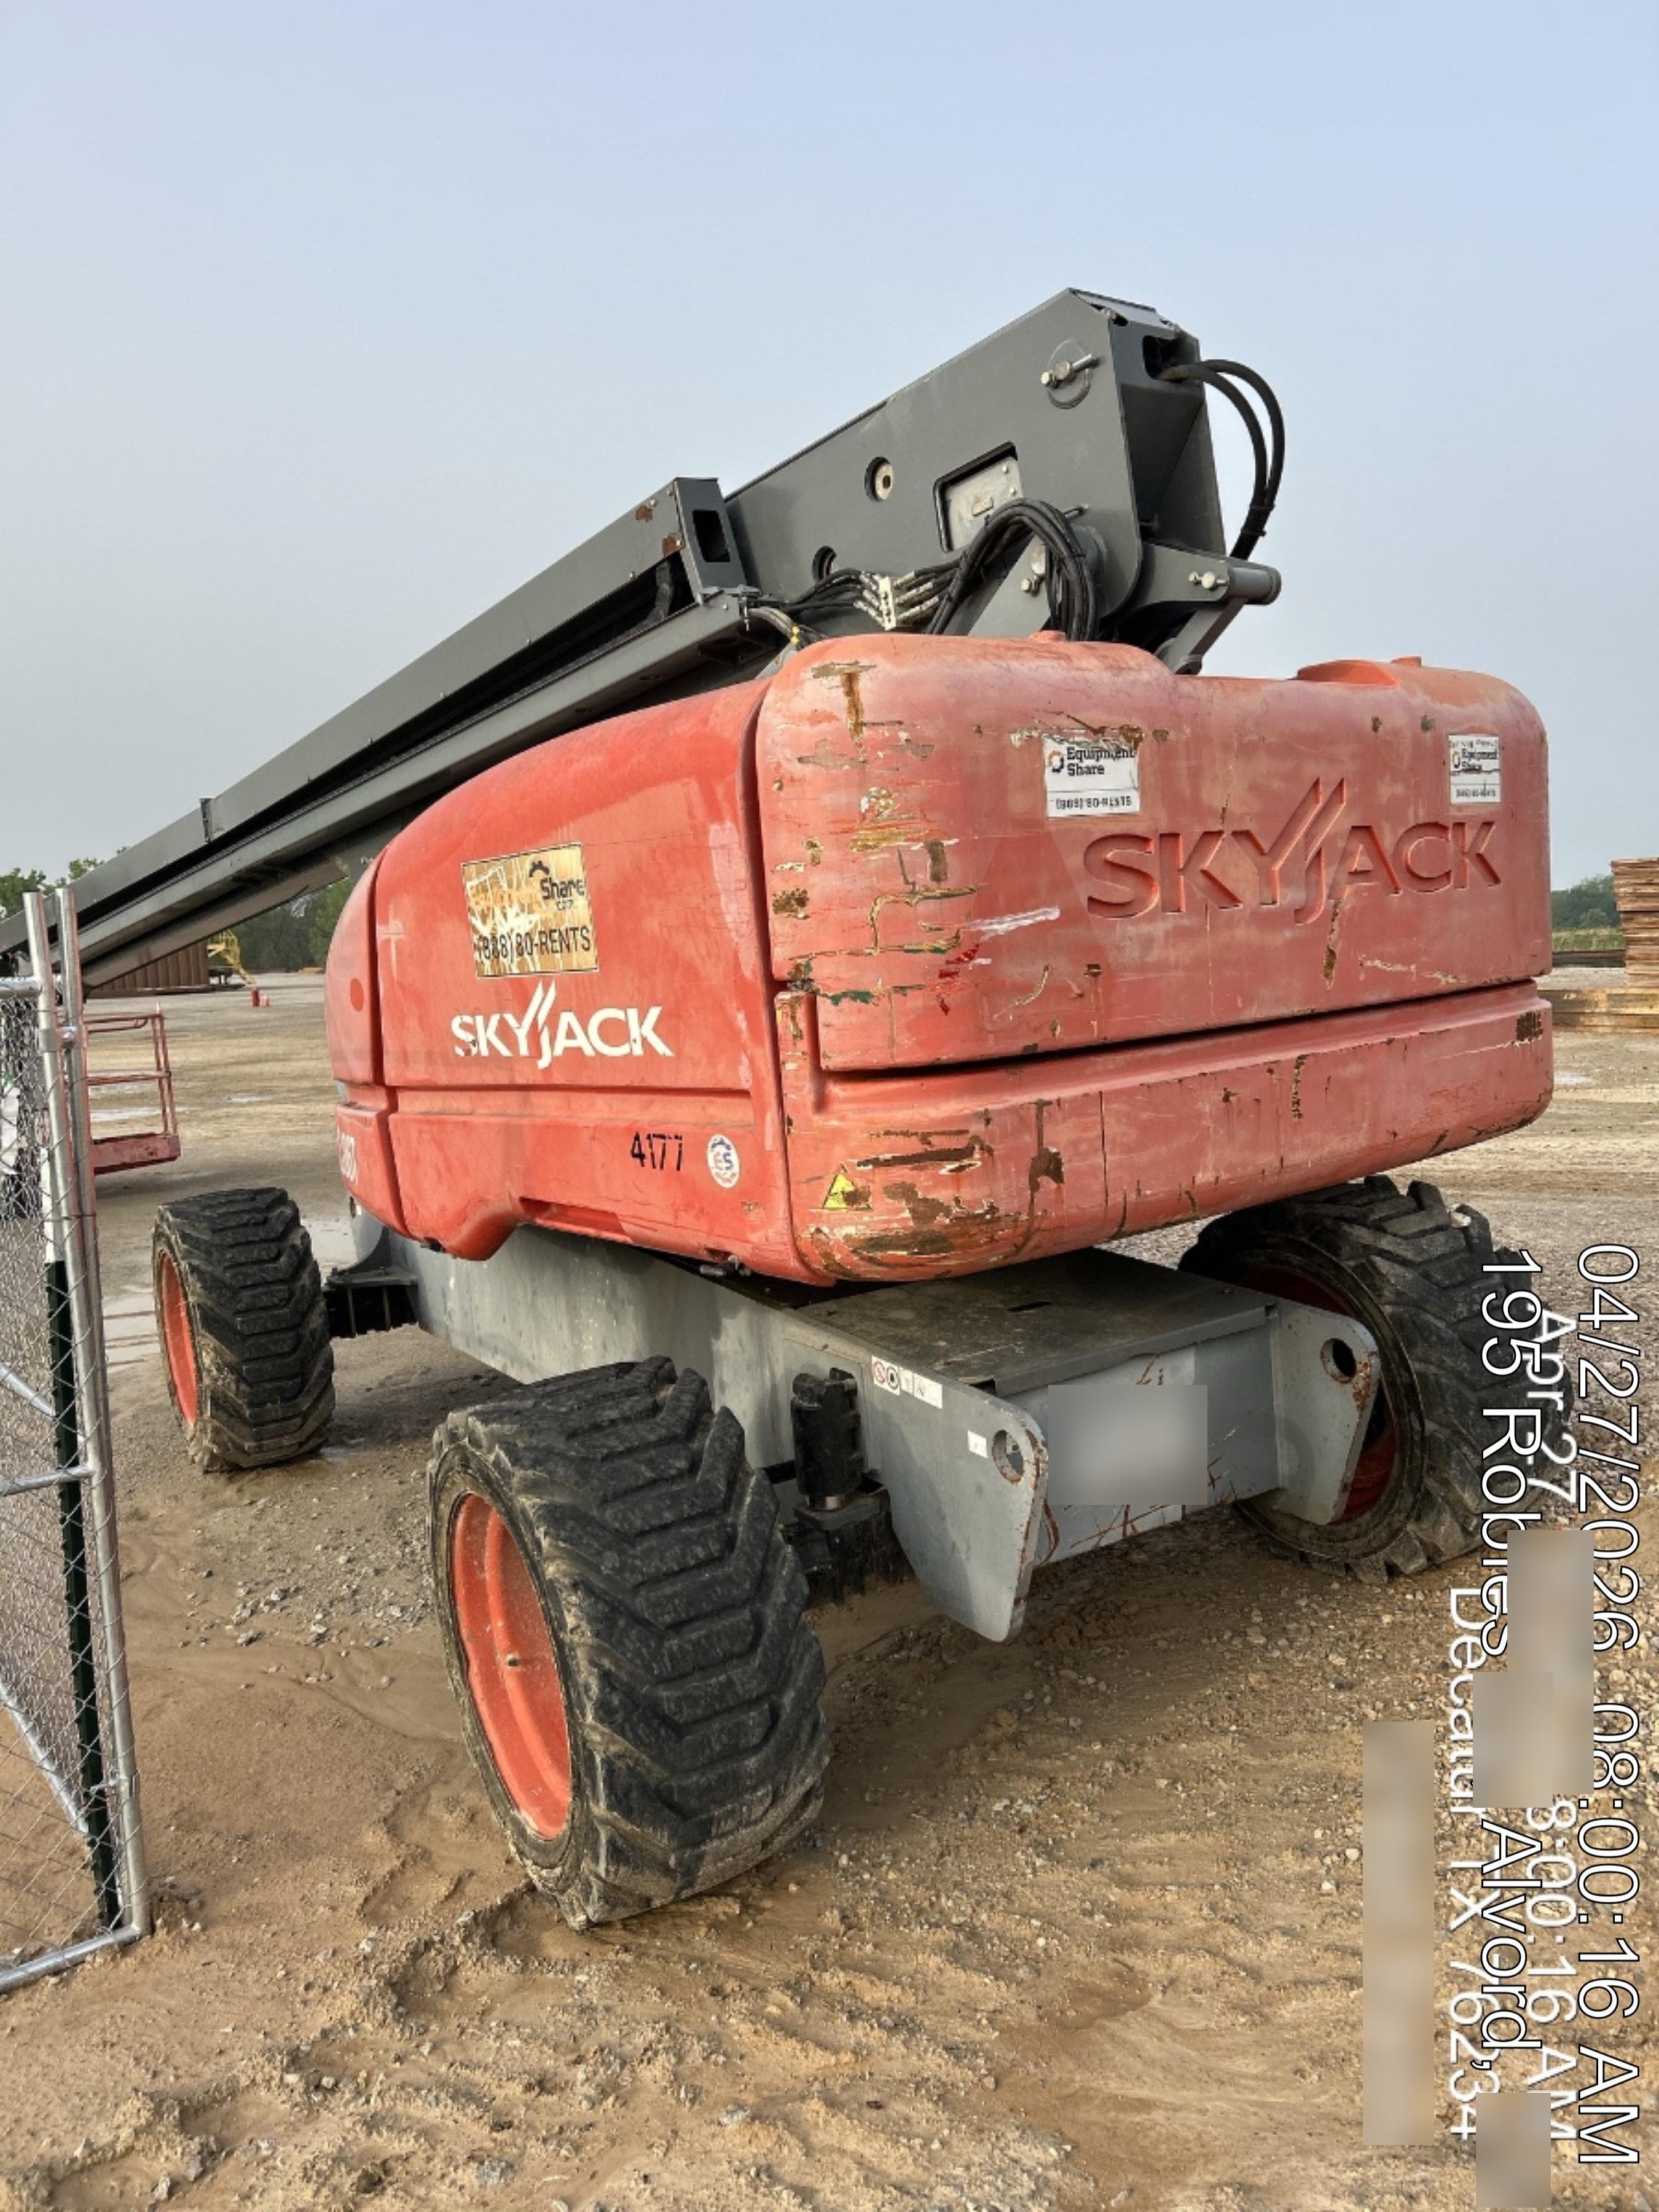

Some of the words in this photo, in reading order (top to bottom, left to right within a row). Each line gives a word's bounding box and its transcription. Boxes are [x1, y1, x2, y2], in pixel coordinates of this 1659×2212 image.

[1067, 763, 1105, 776] Share
[1083, 777, 1502, 925] SKYJACK
[540, 877, 586, 900] Share
[451, 979, 672, 1069] SKYJACK
[630, 1131, 683, 1171] 4177
